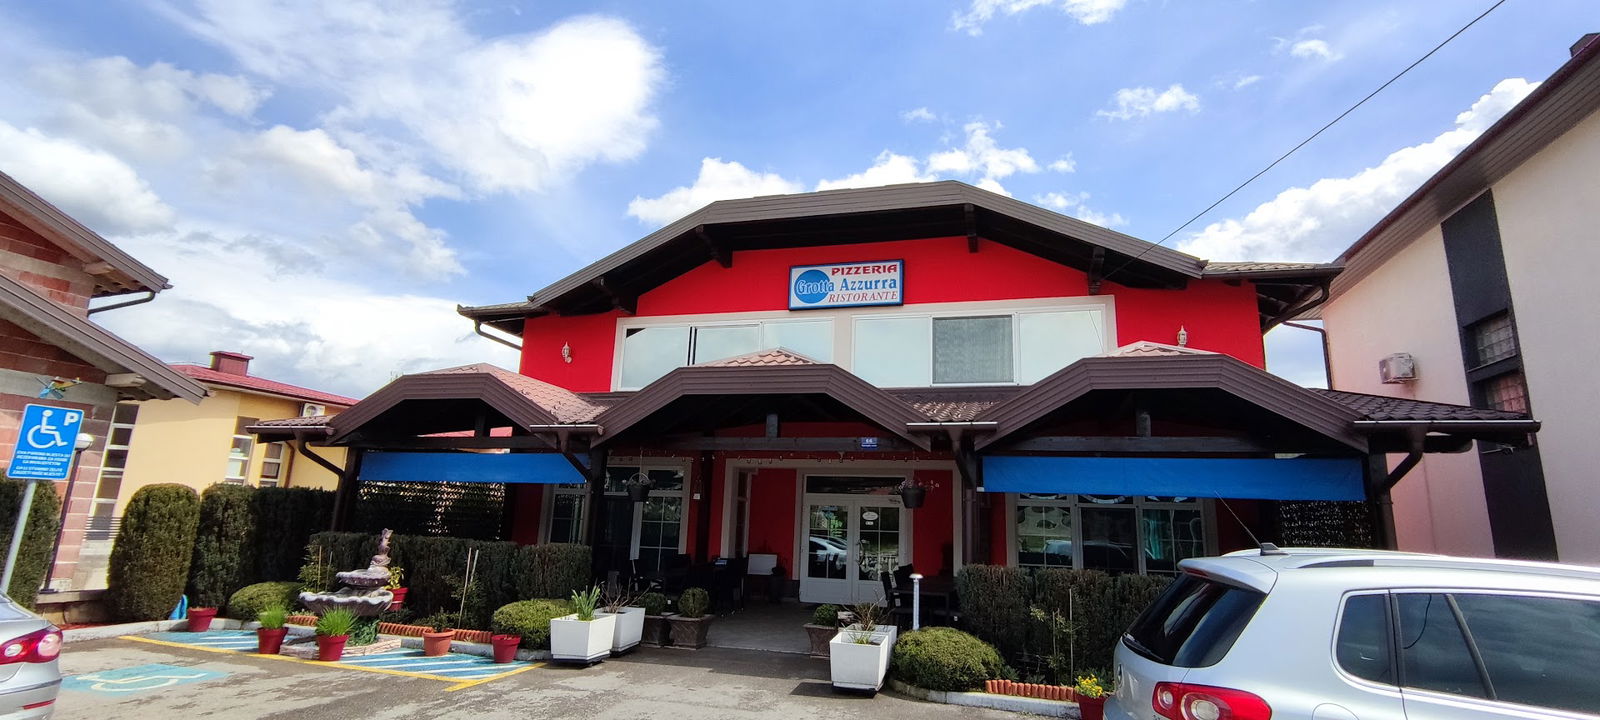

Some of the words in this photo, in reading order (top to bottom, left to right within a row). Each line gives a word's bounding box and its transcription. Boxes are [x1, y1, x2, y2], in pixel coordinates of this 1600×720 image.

[831, 264, 897, 276] PIZZERIA
[796, 280, 835, 295] Grotta
[840, 278, 897, 291] Azzurra
[828, 291, 898, 303] RISTORANTE
[63, 411, 79, 426] P
